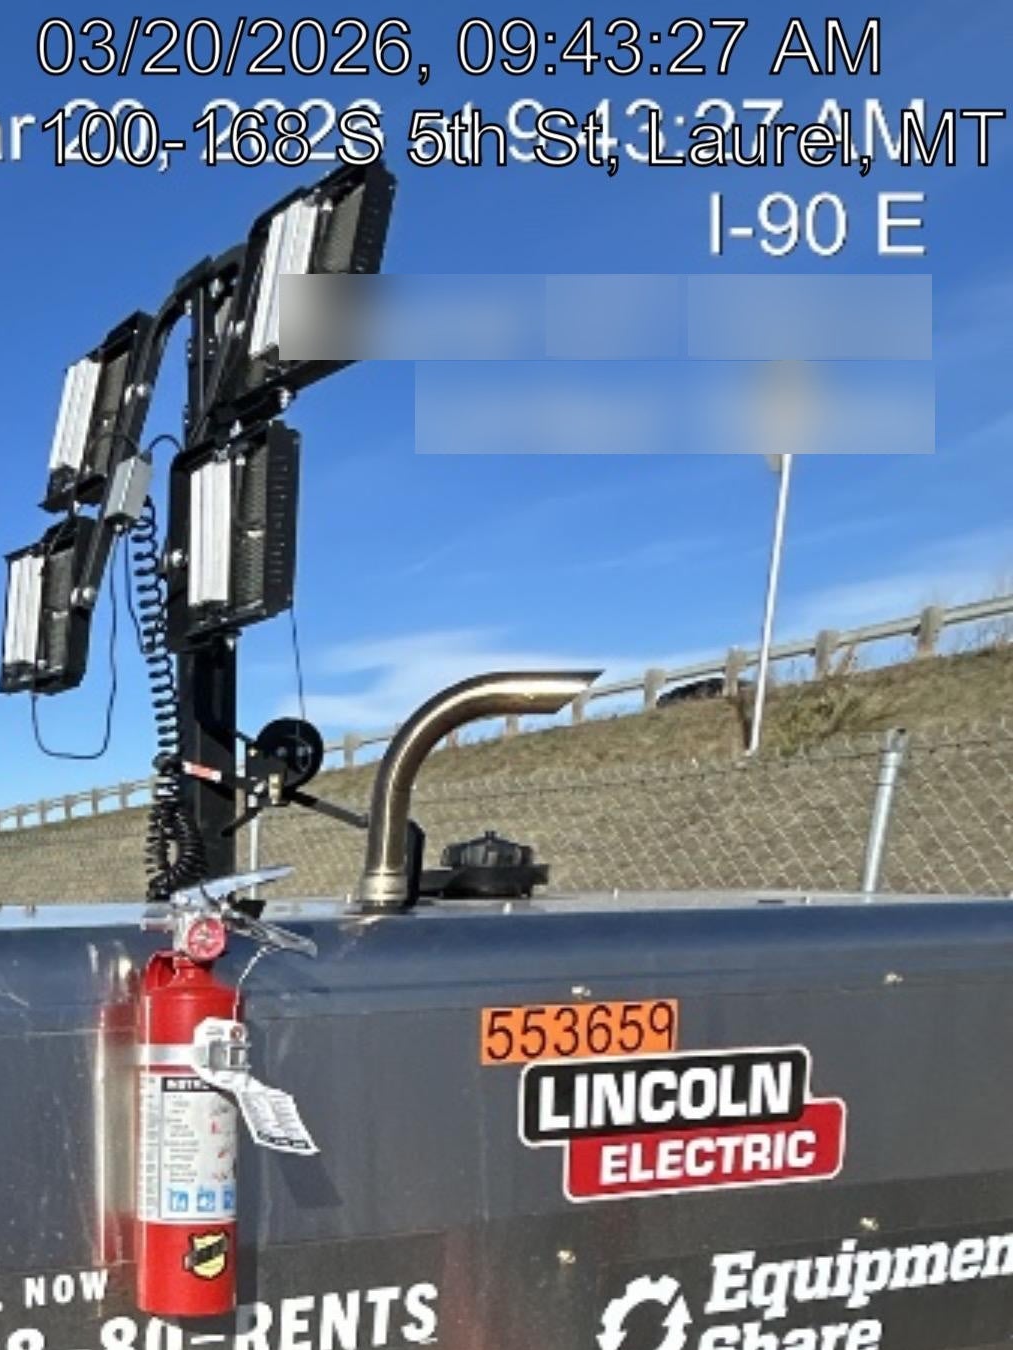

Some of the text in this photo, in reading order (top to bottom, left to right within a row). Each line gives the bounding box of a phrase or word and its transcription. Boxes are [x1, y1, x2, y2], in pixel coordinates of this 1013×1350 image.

[486, 1001, 676, 1060] 553659
[538, 1061, 793, 1132] LINCOLN
[599, 1130, 817, 1185] ELECTRIC
[24, 1269, 109, 1309] NOW
